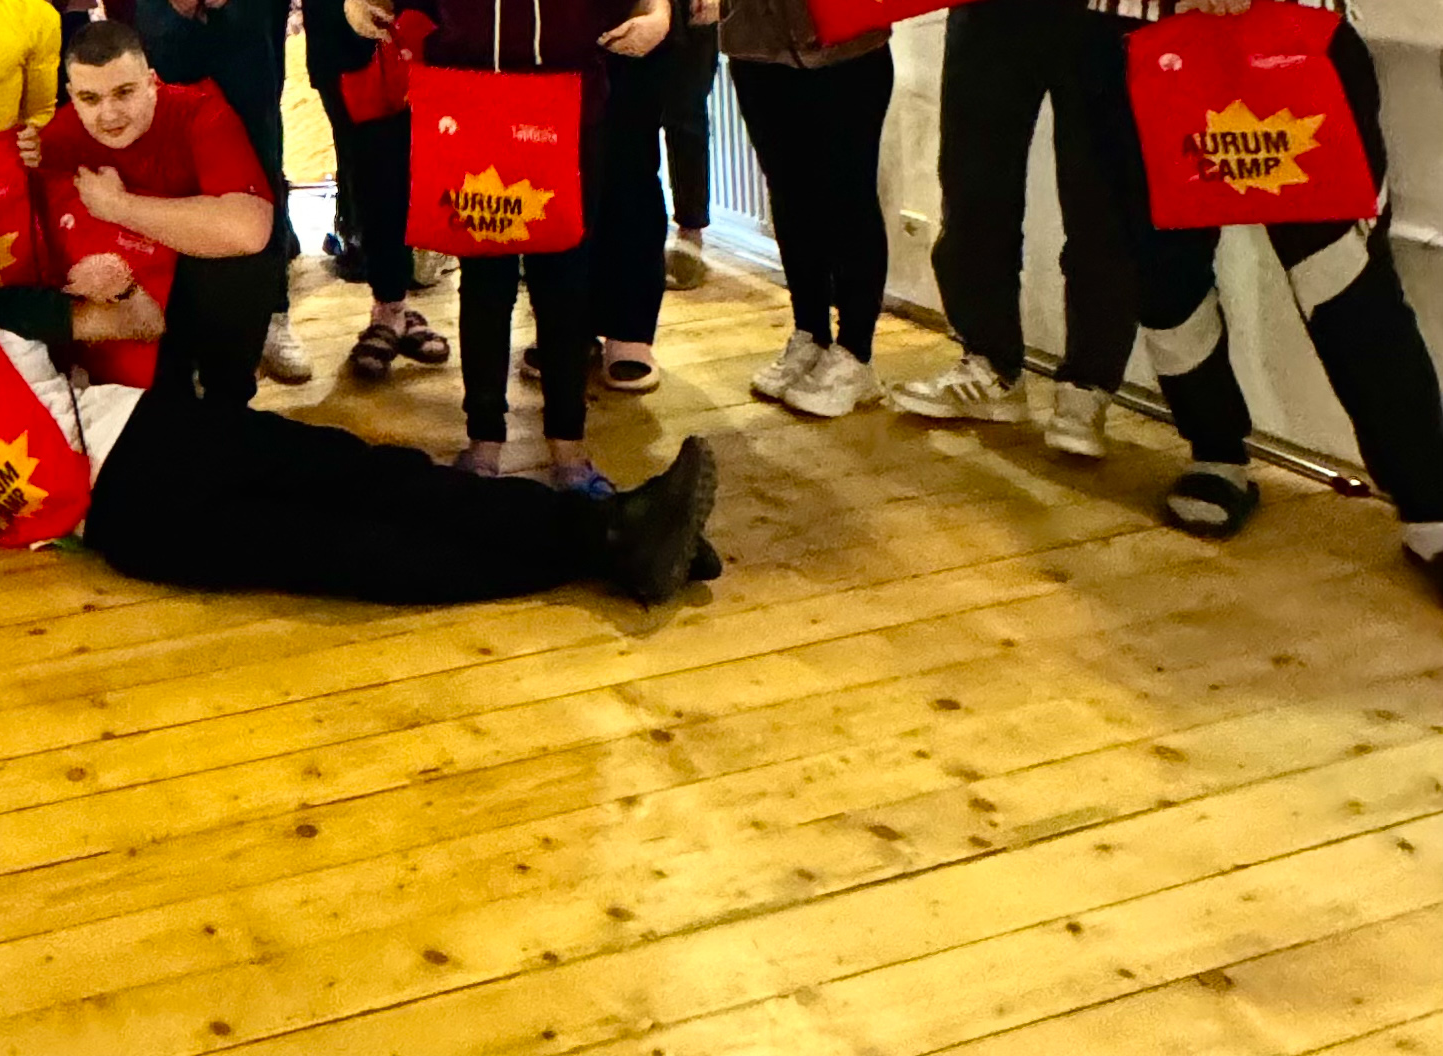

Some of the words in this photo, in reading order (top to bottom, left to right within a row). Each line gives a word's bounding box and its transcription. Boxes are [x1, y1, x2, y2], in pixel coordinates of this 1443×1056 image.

[1182, 130, 1289, 157] AURUM
[1198, 156, 1280, 182] CAMP
[440, 189, 522, 216] AURUM
[448, 215, 513, 234] CAMP
